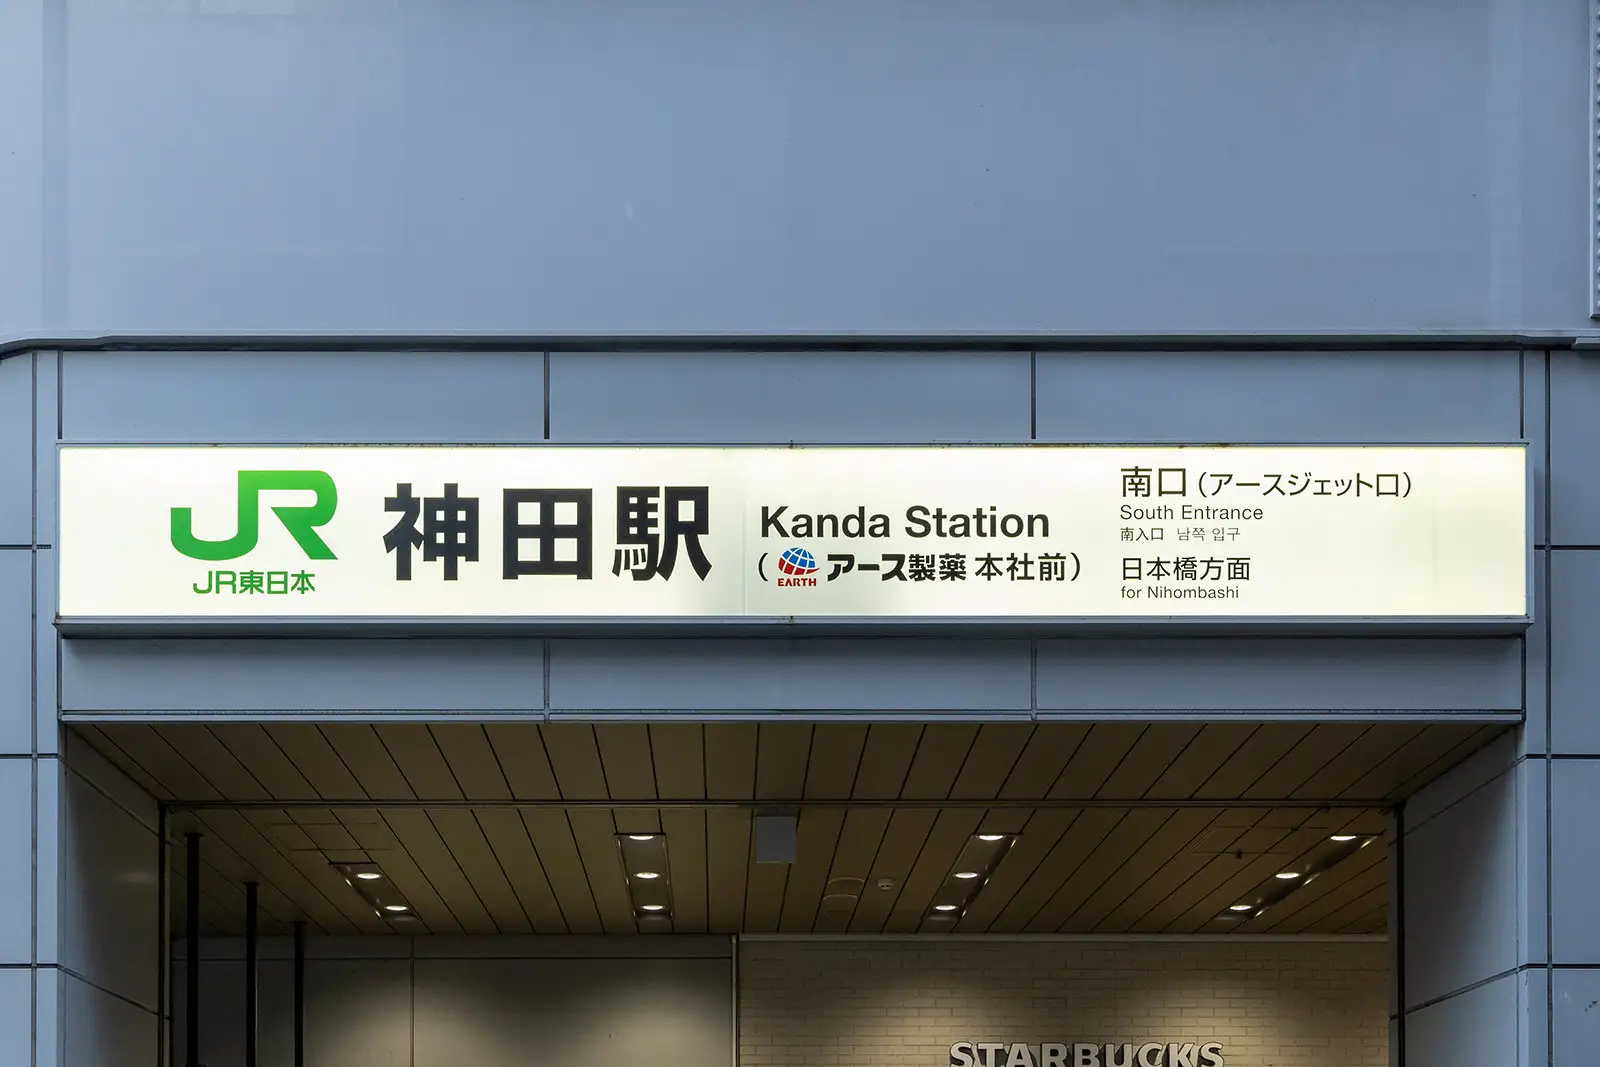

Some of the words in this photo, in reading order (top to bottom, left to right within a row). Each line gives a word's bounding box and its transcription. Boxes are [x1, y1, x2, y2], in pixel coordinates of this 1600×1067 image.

[1121, 466, 1186, 497] 南口
[170, 470, 338, 561] JR
[762, 506, 890, 538] Kanda
[905, 505, 1049, 538] Station
[1120, 505, 1173, 520] South
[1182, 505, 1263, 520] Entrance
[383, 483, 712, 583] 神田駅
[1120, 527, 1163, 541] 南入口
[1177, 527, 1205, 541] 남쪽
[1212, 527, 1240, 541] 입구
[1123, 557, 1250, 581] 日本橋方面
[193, 570, 315, 595] JR東日本
[778, 578, 816, 587] EARTH
[1121, 586, 1142, 599] for
[1148, 586, 1238, 598] Nihombashi
[949, 1041, 1224, 1067] STARBUCKS
